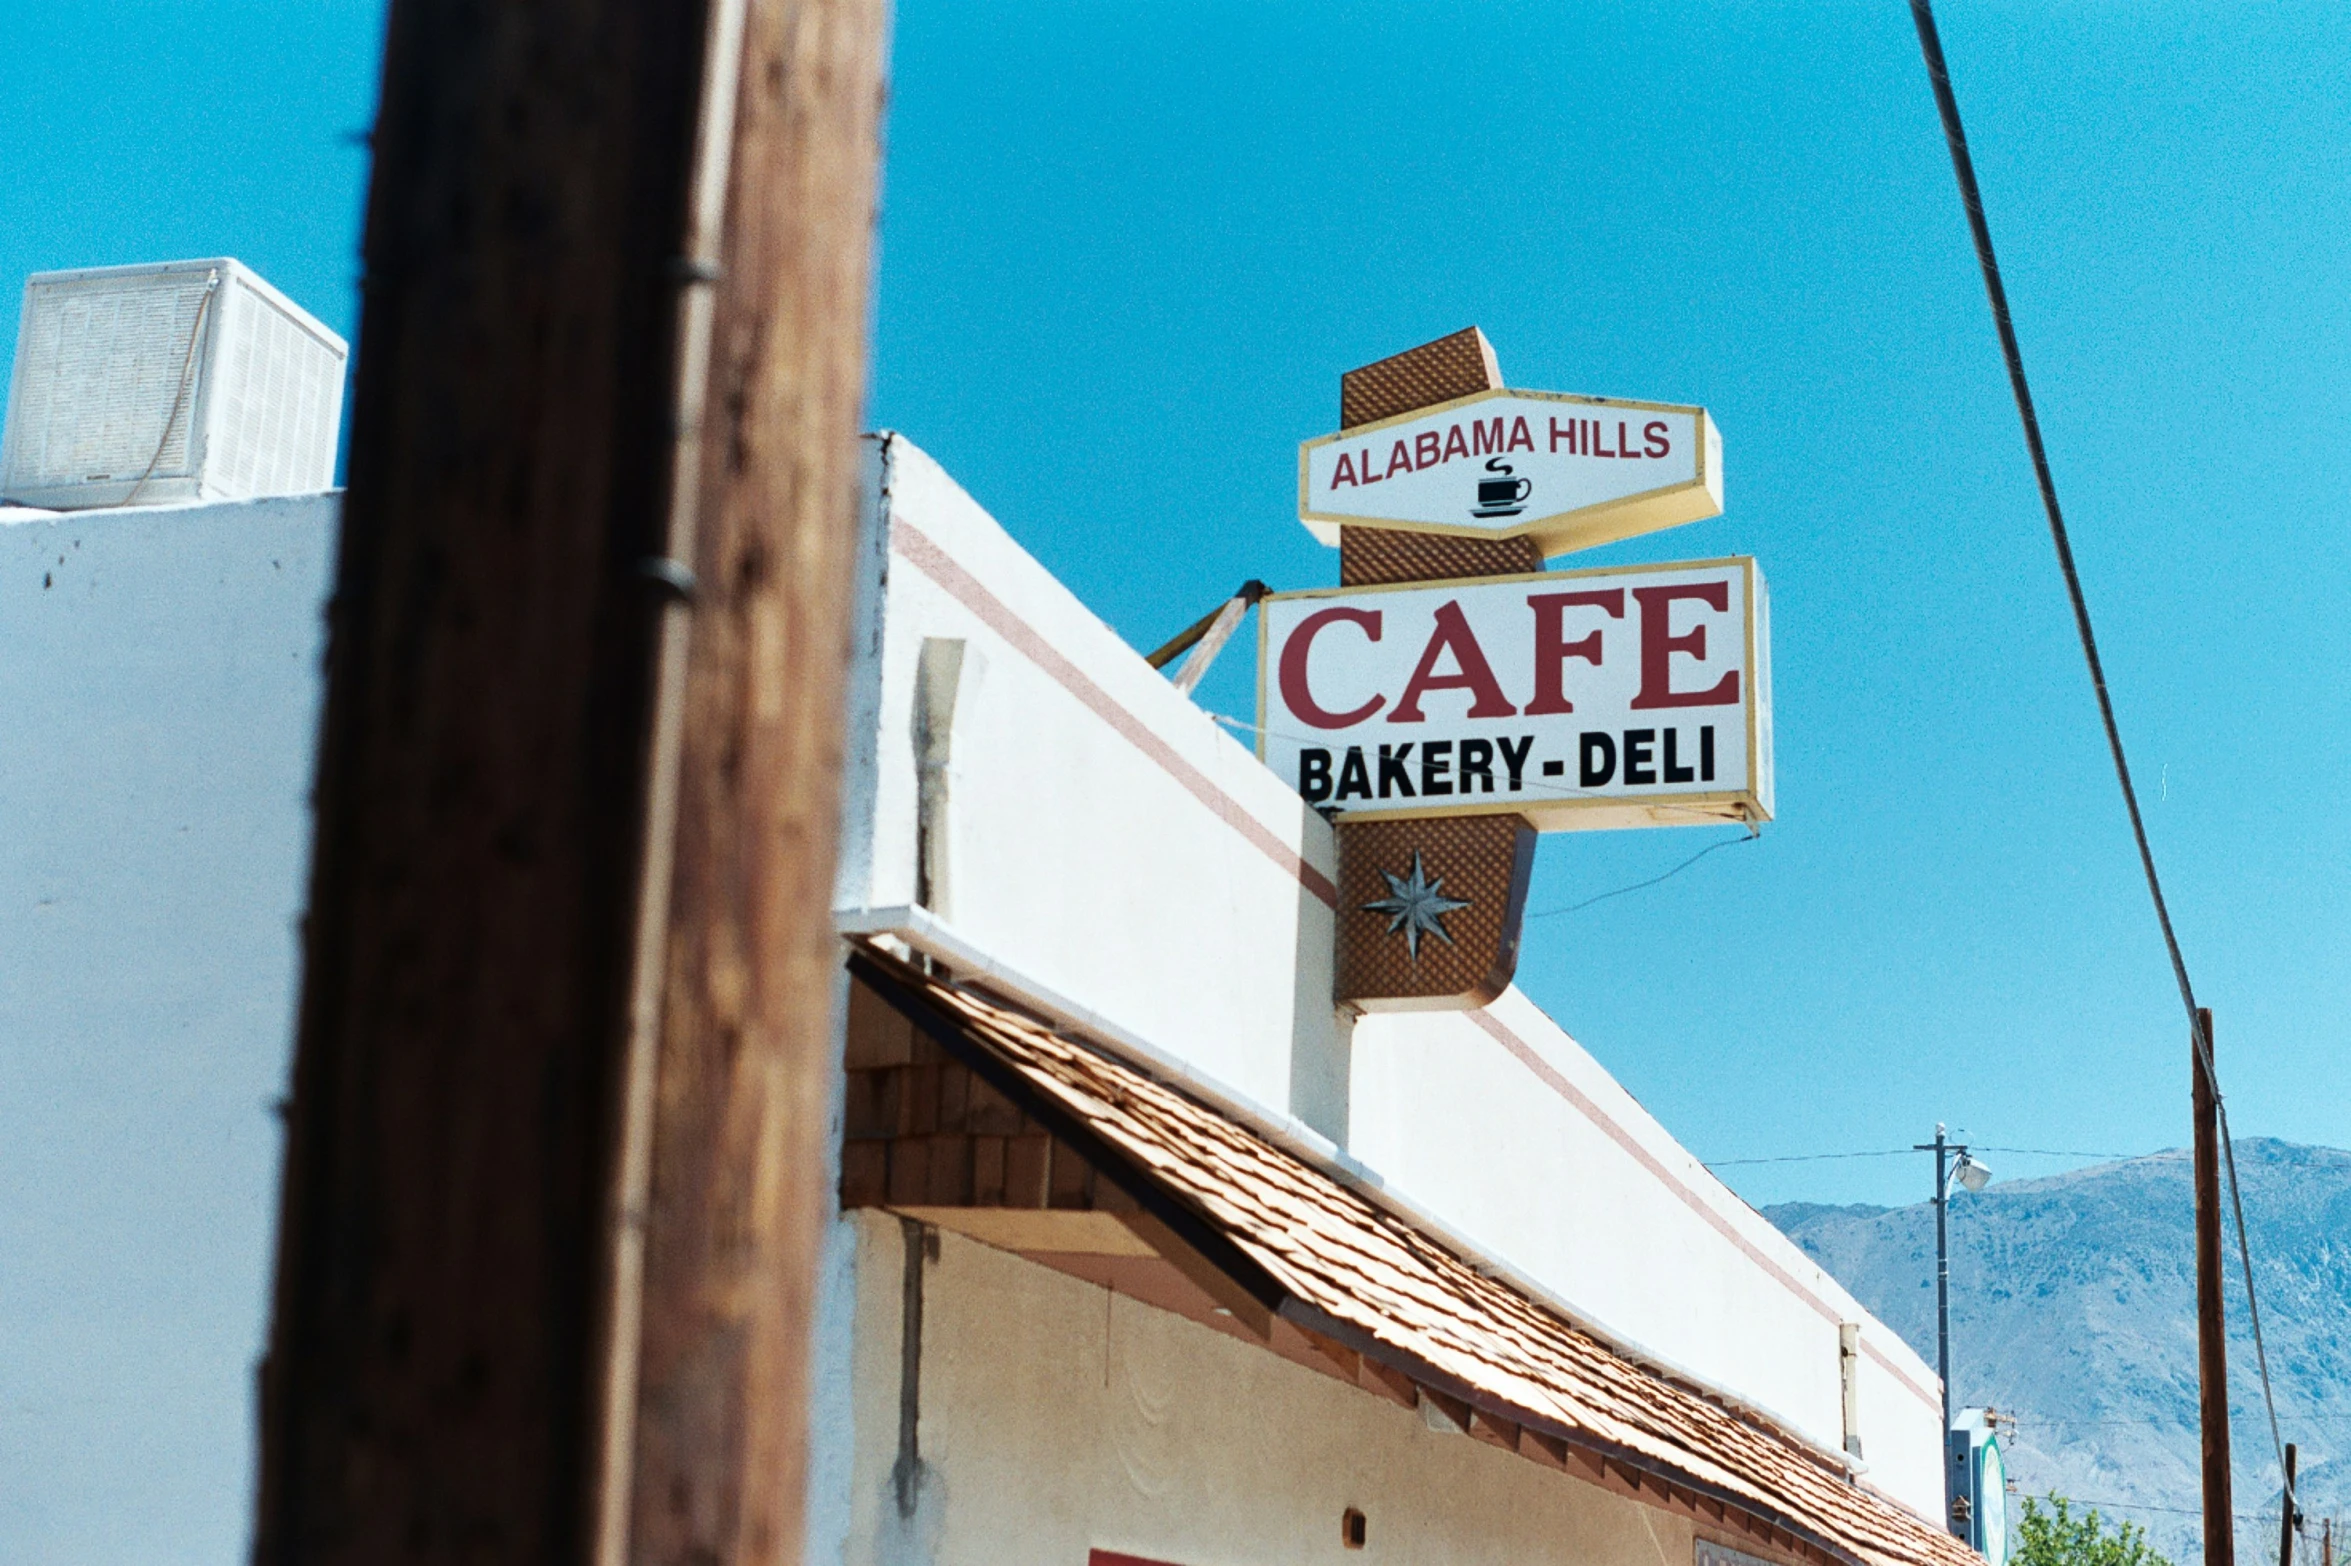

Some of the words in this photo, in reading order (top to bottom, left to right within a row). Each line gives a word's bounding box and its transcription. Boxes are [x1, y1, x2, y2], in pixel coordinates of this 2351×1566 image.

[1330, 415, 1535, 490] ALABAMA
[1549, 416, 1671, 458] HILLS
[1278, 580, 1740, 730] CAFE
